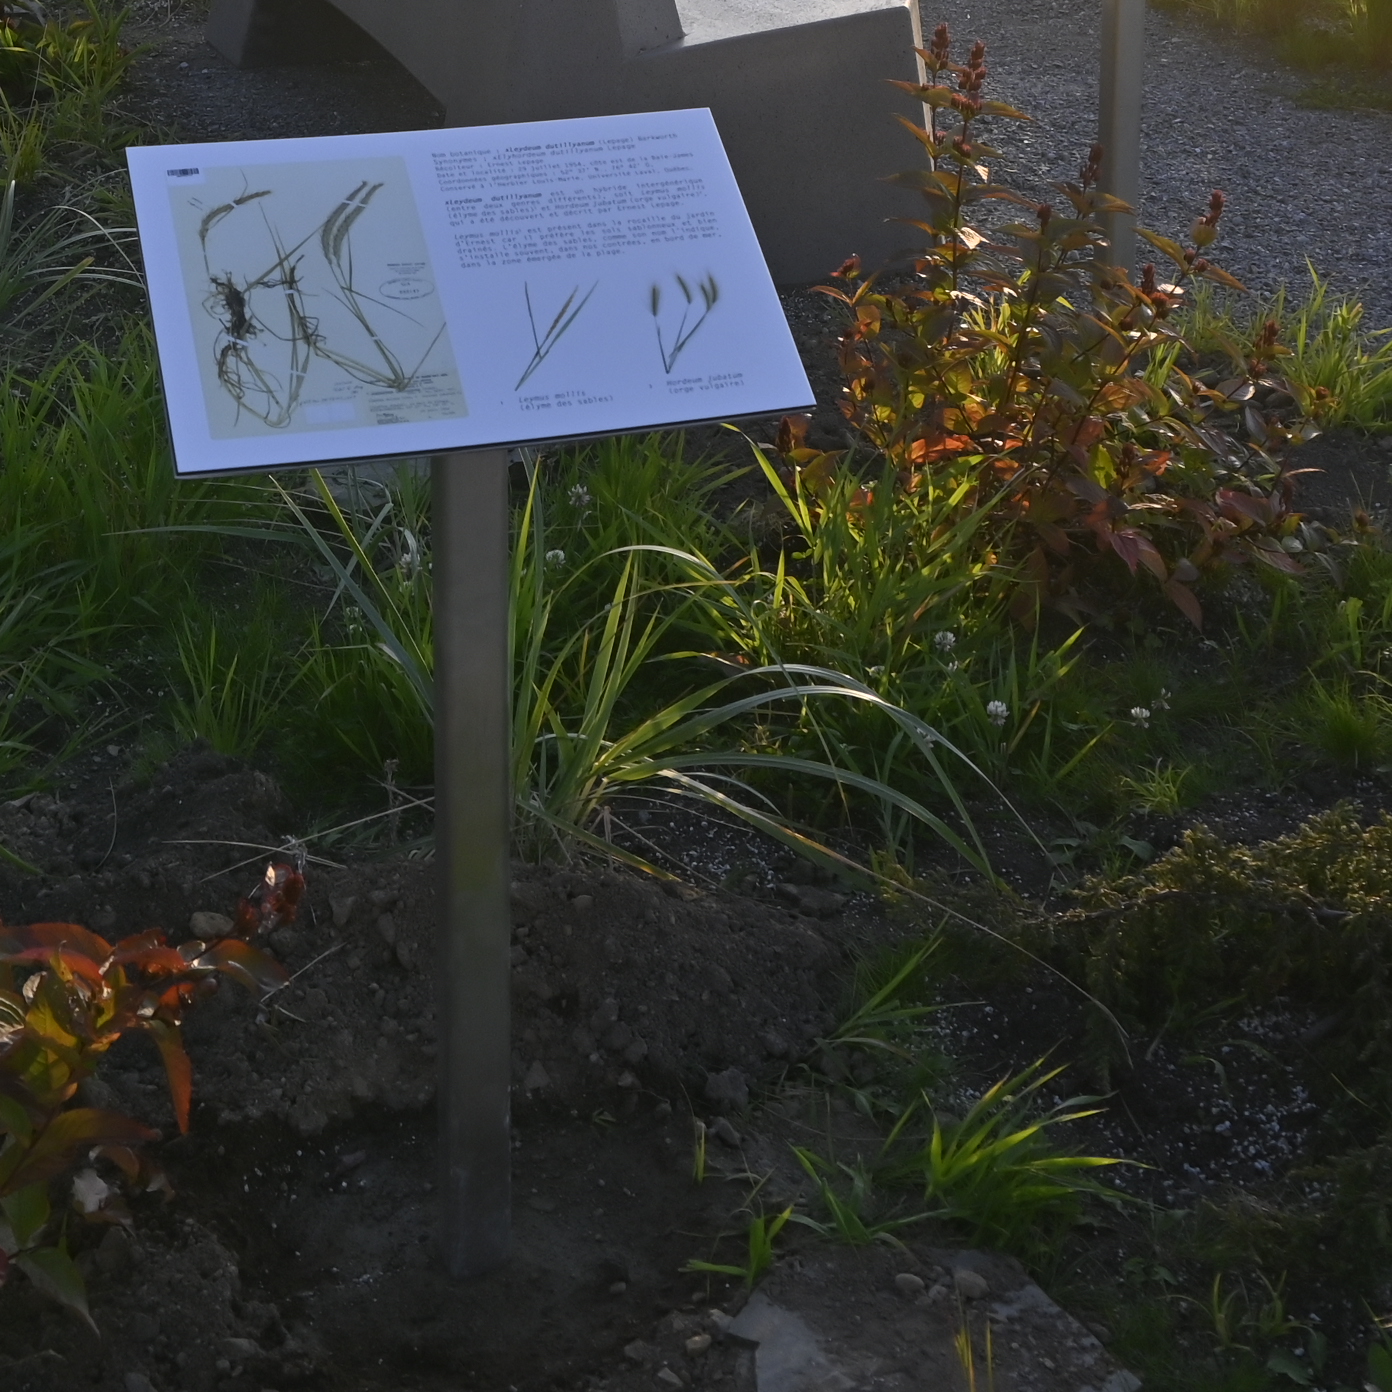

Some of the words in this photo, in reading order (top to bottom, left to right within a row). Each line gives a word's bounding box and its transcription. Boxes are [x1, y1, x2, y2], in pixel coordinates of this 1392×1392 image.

[545, 141, 595, 150] dutillyanum
[598, 137, 634, 145] (Lepage)
[637, 134, 678, 142] Barkworth
[433, 158, 478, 166] Synonymes
[550, 147, 604, 156] dutillyanum
[531, 164, 560, 172] juillet
[438, 178, 487, 186] Coordonnées
[491, 173, 548, 182] géographiques
[588, 172, 631, 180] Université
[491, 193, 543, 202] dutillyanum
[593, 185, 627, 194] hybride
[636, 179, 703, 189] intergénérique
[548, 194, 606, 204] différents),
[676, 186, 705, 194] mollis
[593, 199, 627, 208] jubatum
[500, 213, 545, 222] découvert
[547, 224, 582, 233] présent
[627, 216, 666, 224] rocaille
[686, 212, 715, 220] jardin
[455, 239, 496, 247] d'Ernest
[539, 232, 574, 241] préfère
[628, 223, 676, 232] sablonneux
[459, 252, 510, 262] s'installe
[666, 378, 703, 386] Hordeum
[708, 373, 743, 384] jubatum
[699, 380, 745, 391] vulgaire)
[518, 396, 550, 404] Leymus
[554, 391, 586, 399] mollis
[520, 403, 552, 412] (élyme
[577, 395, 614, 405] sables)
